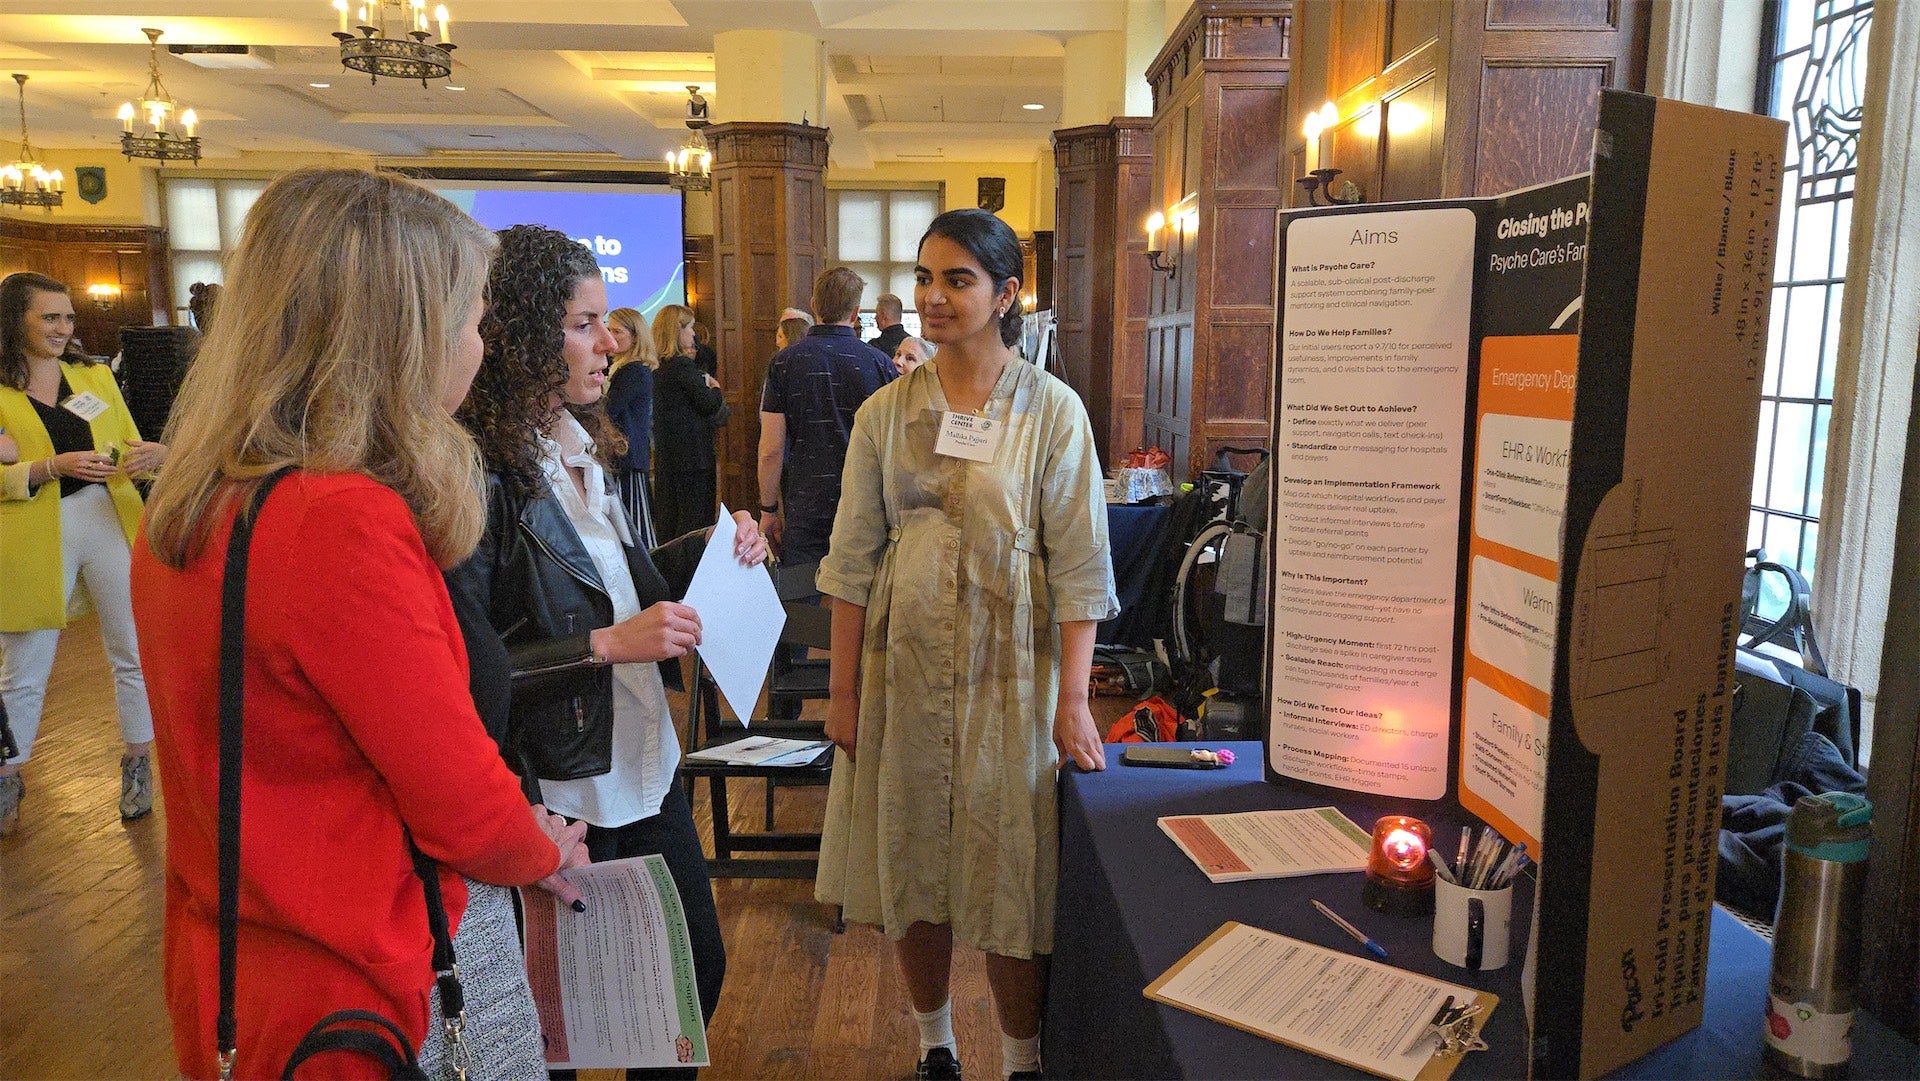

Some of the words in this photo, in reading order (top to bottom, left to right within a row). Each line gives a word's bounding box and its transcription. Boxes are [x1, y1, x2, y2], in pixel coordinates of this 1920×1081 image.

[1497, 213, 1548, 239] Closing
[1550, 207, 1573, 230] the
[594, 235, 621, 255] to
[1350, 230, 1398, 245] Aims
[1318, 263, 1348, 272] Psyche
[1349, 262, 1375, 270] Care?
[1490, 254, 1528, 274] Psyche
[1530, 244, 1564, 267] Care's
[599, 267, 628, 283] ns
[1331, 330, 1350, 338] Help
[1492, 368, 1551, 391] Emergency
[1554, 370, 1575, 393] Dep
[951, 420, 973, 428] CENTER
[952, 414, 973, 422] THRIVE
[1502, 441, 1524, 460] EHR
[1526, 446, 1533, 461] &
[1536, 446, 1568, 468] Workf
[1284, 476, 1312, 485] Develop
[1324, 478, 1389, 489] Implementation
[1391, 481, 1440, 490] Framework
[1281, 571, 1295, 580] Why
[1304, 573, 1320, 581] This
[1322, 575, 1368, 587] Important?
[1523, 587, 1553, 615] Warm
[1286, 631, 1337, 643] High-Urgency
[1338, 636, 1374, 646] Moment:
[1286, 654, 1316, 664] Scalable
[1316, 658, 1343, 667] Reach:
[1277, 697, 1292, 705] How
[1293, 699, 1305, 707] Did
[1307, 701, 1318, 709] We
[1320, 703, 1337, 712] Test
[1338, 706, 1353, 715] Our
[1355, 709, 1382, 719] Ideas?
[1284, 711, 1314, 721] Informal
[1314, 715, 1358, 727] Interviews:
[1492, 713, 1523, 748] Family
[1525, 734, 1532, 750] &
[1534, 738, 1546, 760] St
[1670, 710, 1688, 777] Board
[1283, 743, 1312, 754] Process
[1312, 748, 1349, 761] Mapping:
[1656, 787, 1682, 930] Presentation
[1650, 938, 1670, 1018] Tri-Fold
